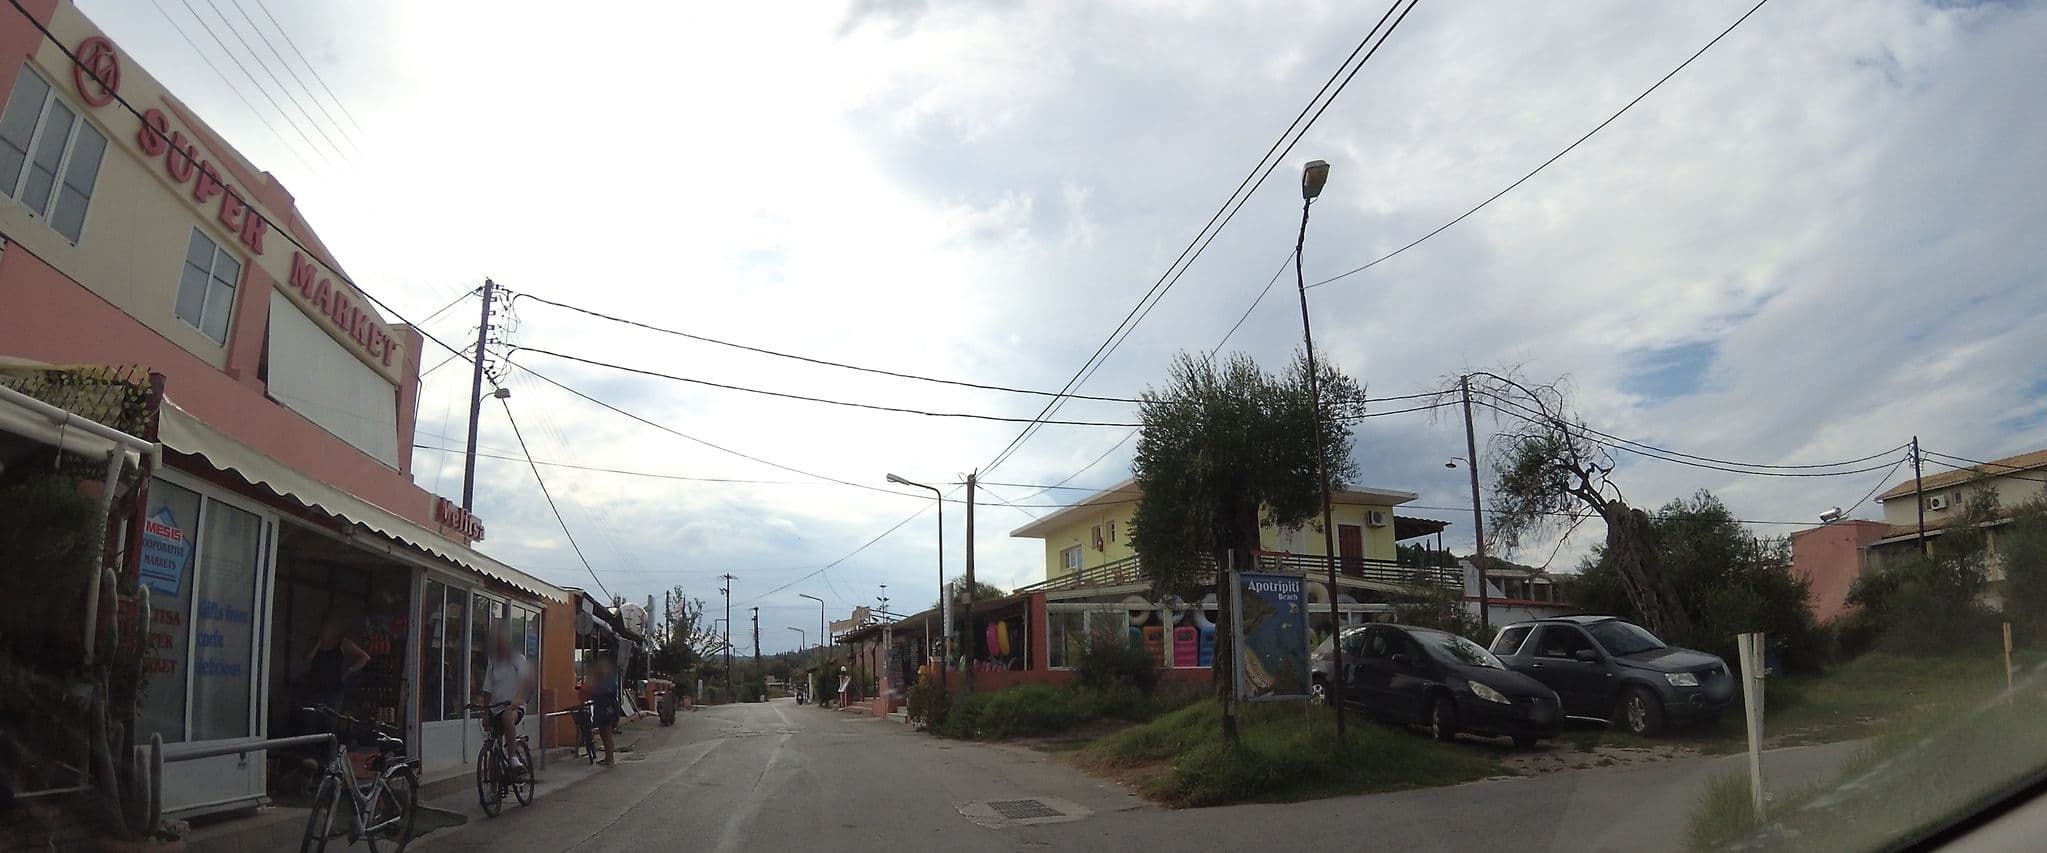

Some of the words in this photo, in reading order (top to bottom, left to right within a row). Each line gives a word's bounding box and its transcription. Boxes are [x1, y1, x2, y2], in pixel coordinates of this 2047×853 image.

[135, 108, 269, 256] SUPER
[288, 250, 400, 367] MARKET
[146, 520, 181, 541] MESIS
[1247, 580, 1300, 594] Apotripiti
[1278, 593, 1298, 601] Beach
